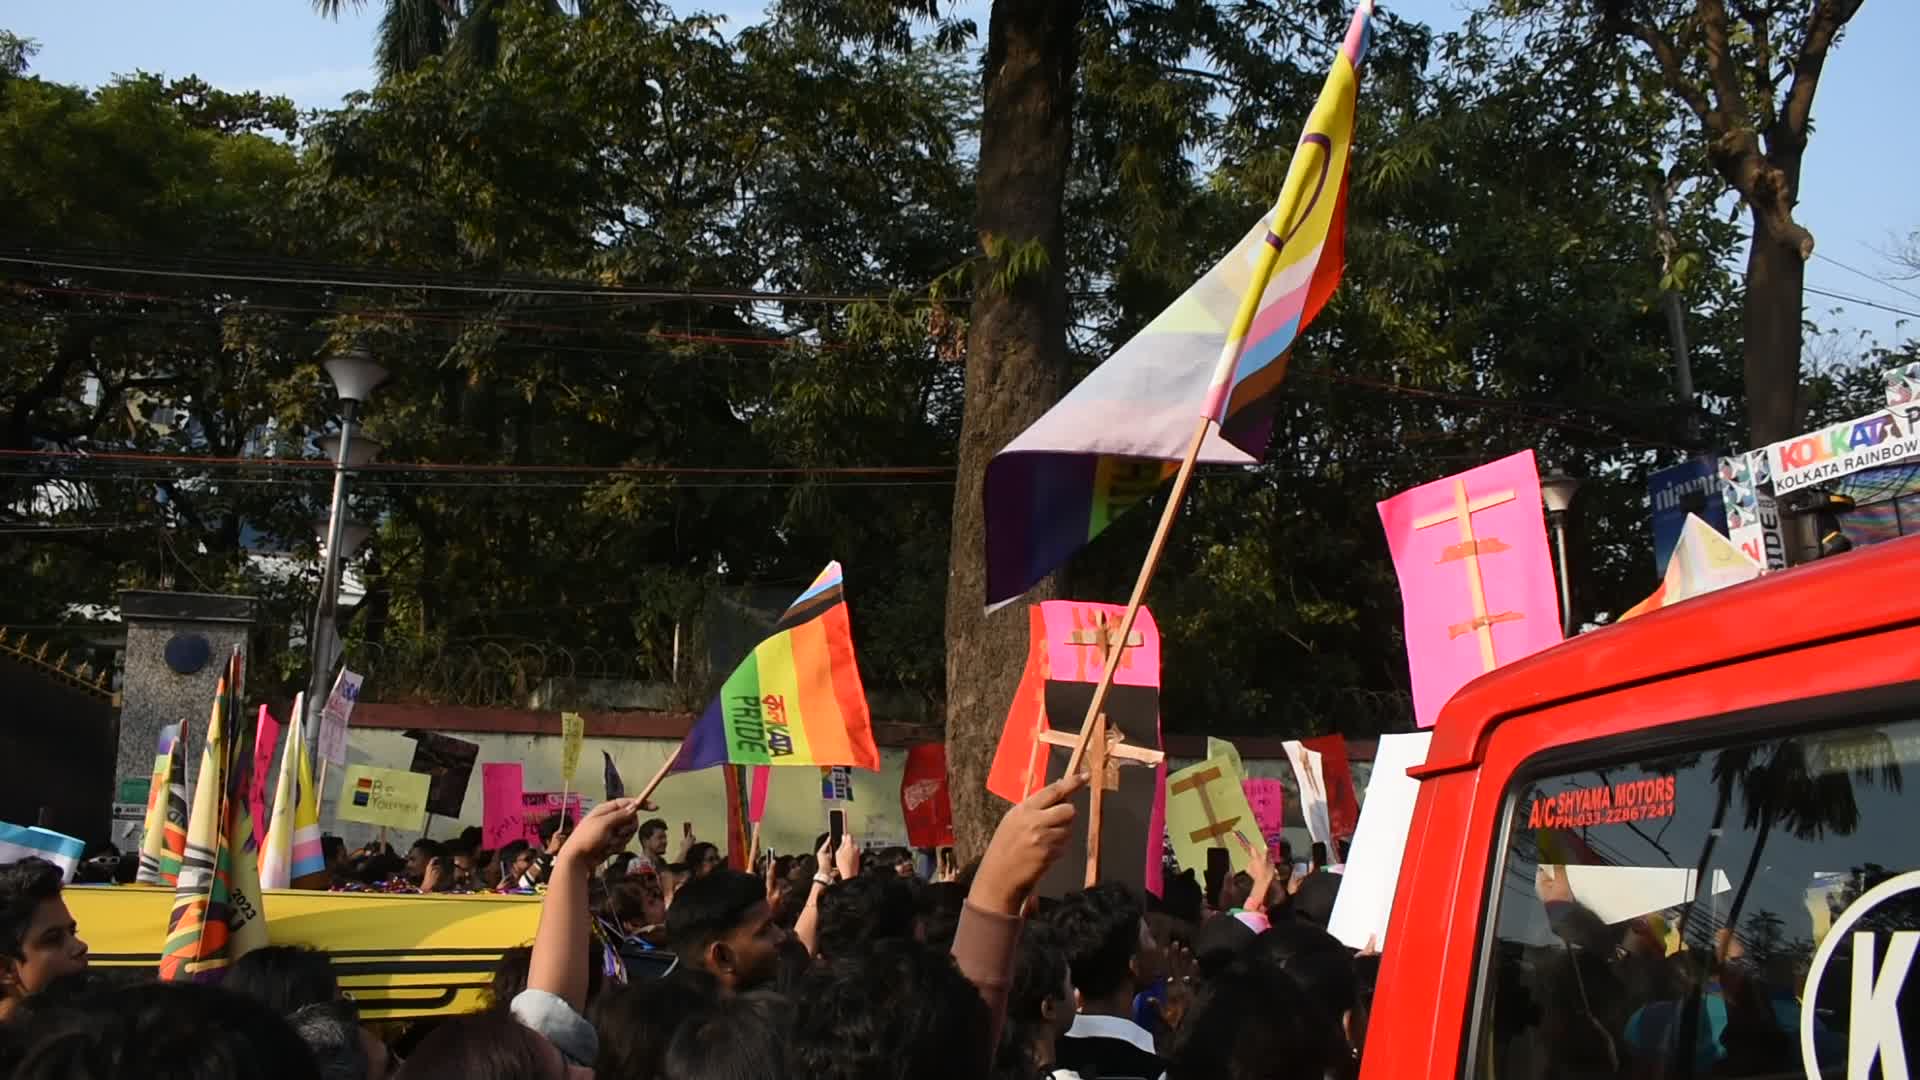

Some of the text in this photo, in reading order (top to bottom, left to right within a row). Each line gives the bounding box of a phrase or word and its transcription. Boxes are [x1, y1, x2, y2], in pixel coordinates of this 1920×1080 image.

[1776, 439, 1918, 491] KOLKATA RAINBOW
[731, 695, 767, 753] PRIDE
[1529, 799, 1556, 828] A/C
[1557, 776, 1674, 814] SHYAMA MOTORS
[231, 887, 257, 920] 2023
